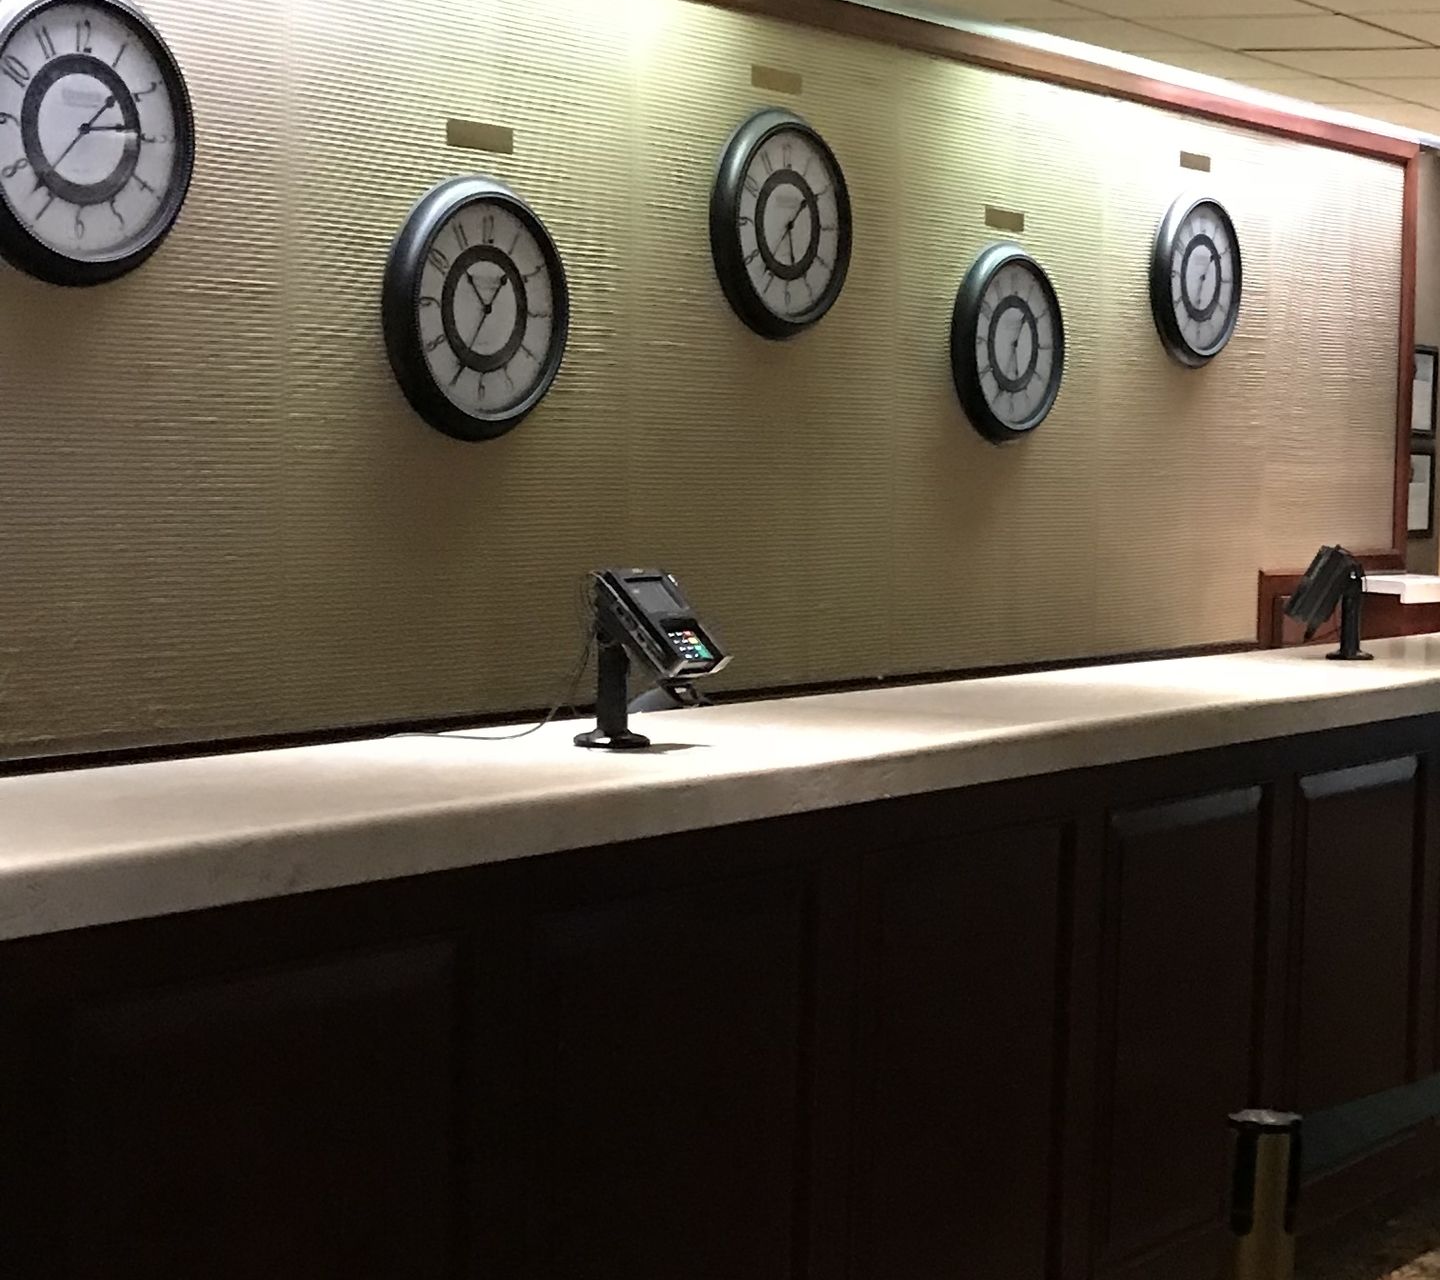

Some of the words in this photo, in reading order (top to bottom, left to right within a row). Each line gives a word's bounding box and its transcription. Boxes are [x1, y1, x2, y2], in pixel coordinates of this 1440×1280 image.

[35, 24, 57, 59] 11
[76, 19, 92, 53] 12
[3, 54, 30, 88] 10
[3, 158, 29, 178] 8
[453, 220, 469, 251] 11
[482, 214, 495, 245] 12
[428, 248, 449, 276] 10
